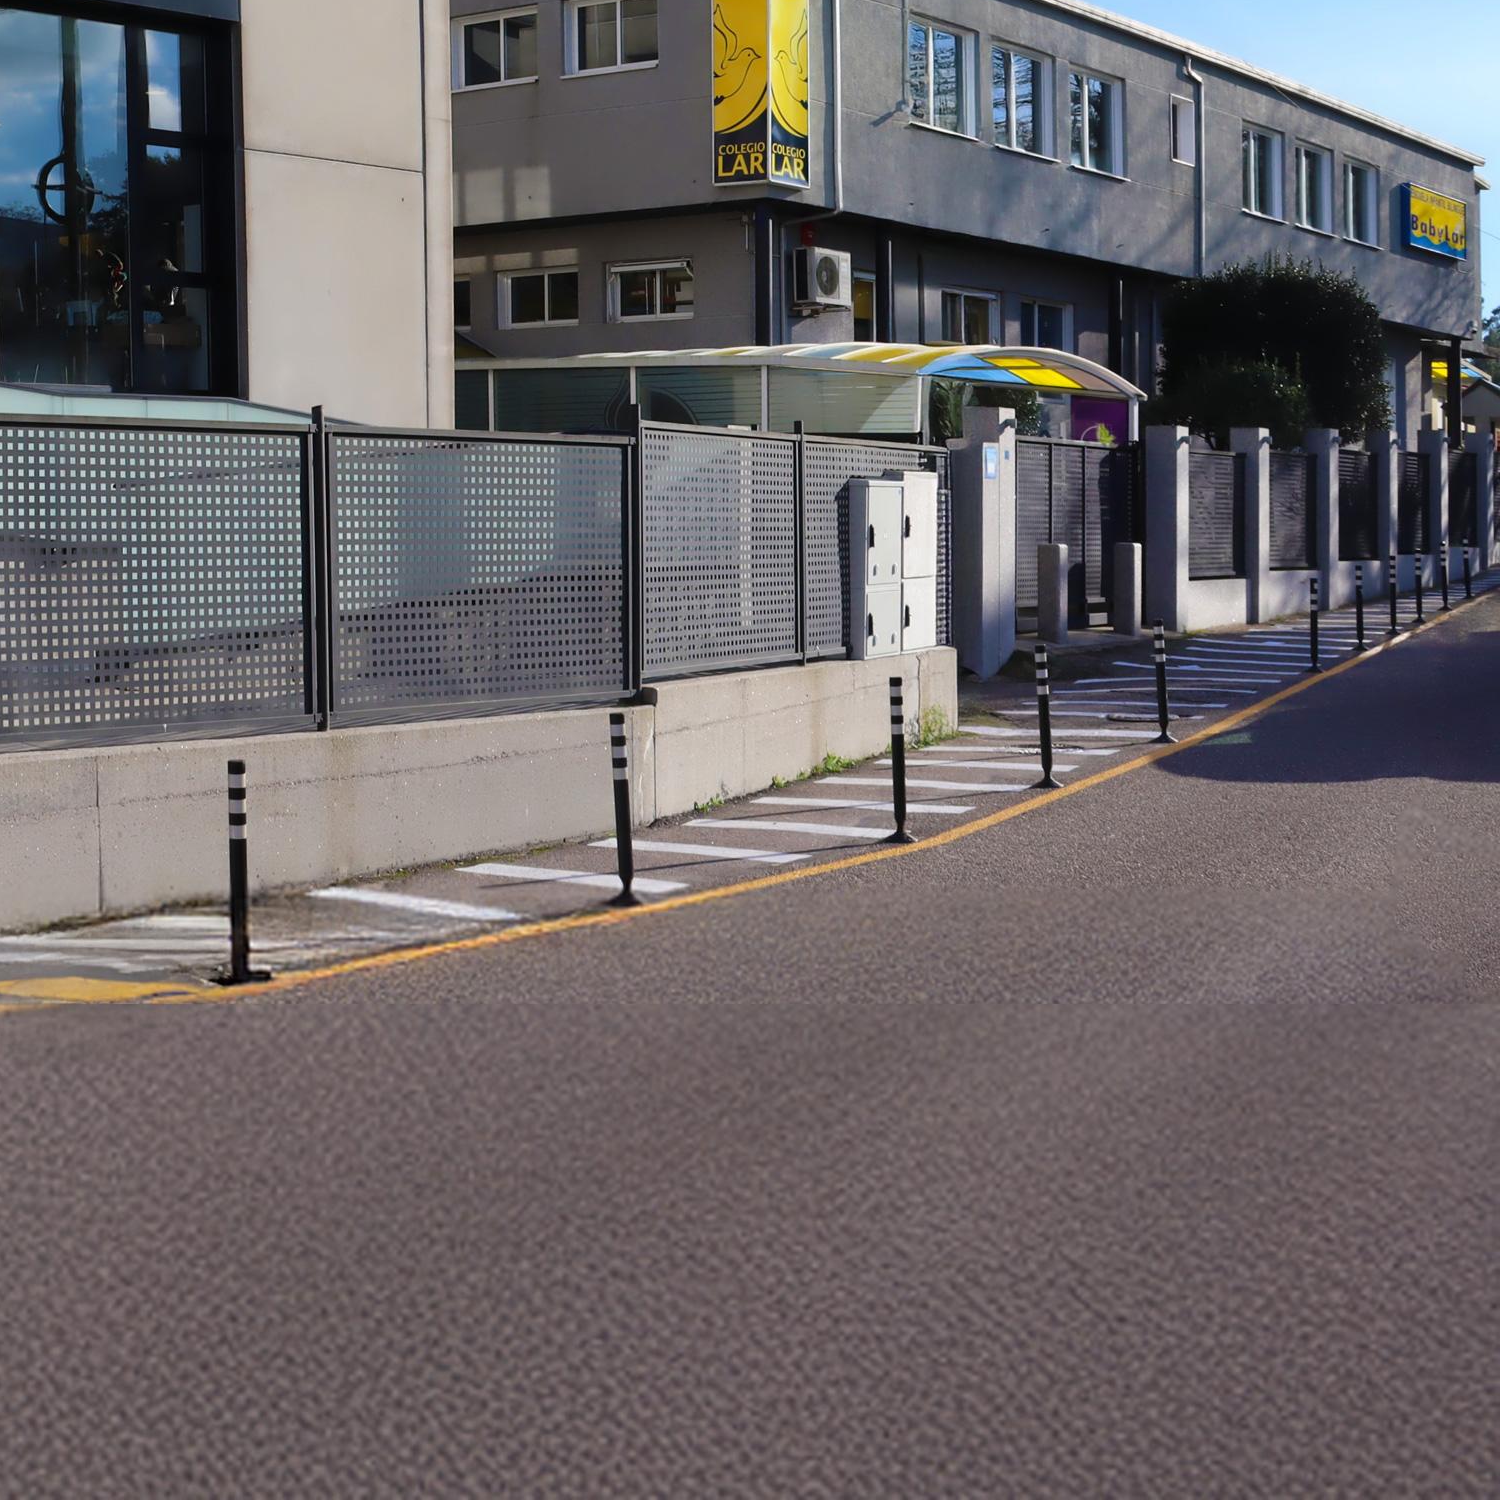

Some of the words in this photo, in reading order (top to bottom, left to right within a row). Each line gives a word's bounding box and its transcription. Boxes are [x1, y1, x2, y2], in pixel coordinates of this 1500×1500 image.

[718, 141, 766, 156] COLEGIO
[772, 142, 806, 159] COLEGIO
[717, 152, 765, 177] LAR
[772, 153, 806, 181] LAR
[1411, 214, 1465, 246] BabyLar
